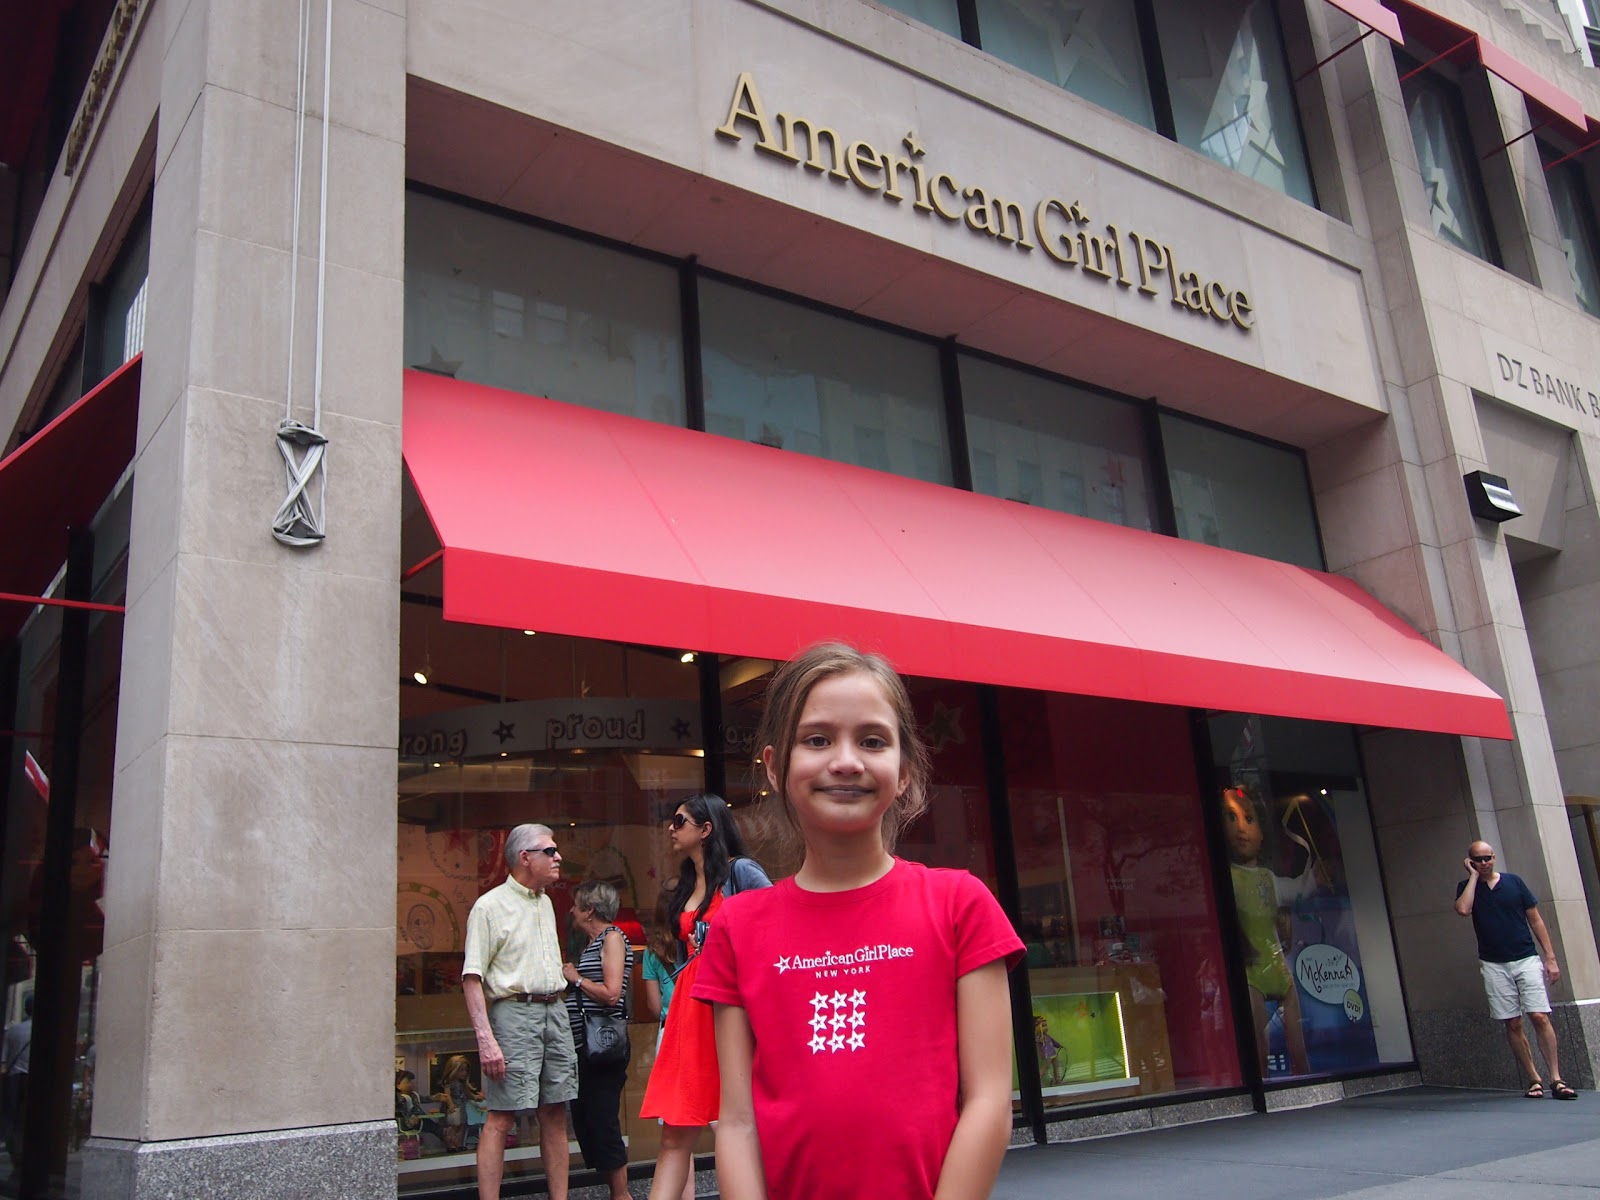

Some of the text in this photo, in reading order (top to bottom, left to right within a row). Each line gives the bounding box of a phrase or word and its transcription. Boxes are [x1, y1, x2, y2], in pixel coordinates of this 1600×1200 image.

[1497, 352, 1600, 419] DZ BANK B
[400, 728, 468, 759] rong
[545, 709, 646, 750] proud
[815, 965, 871, 979] NEW YORK
